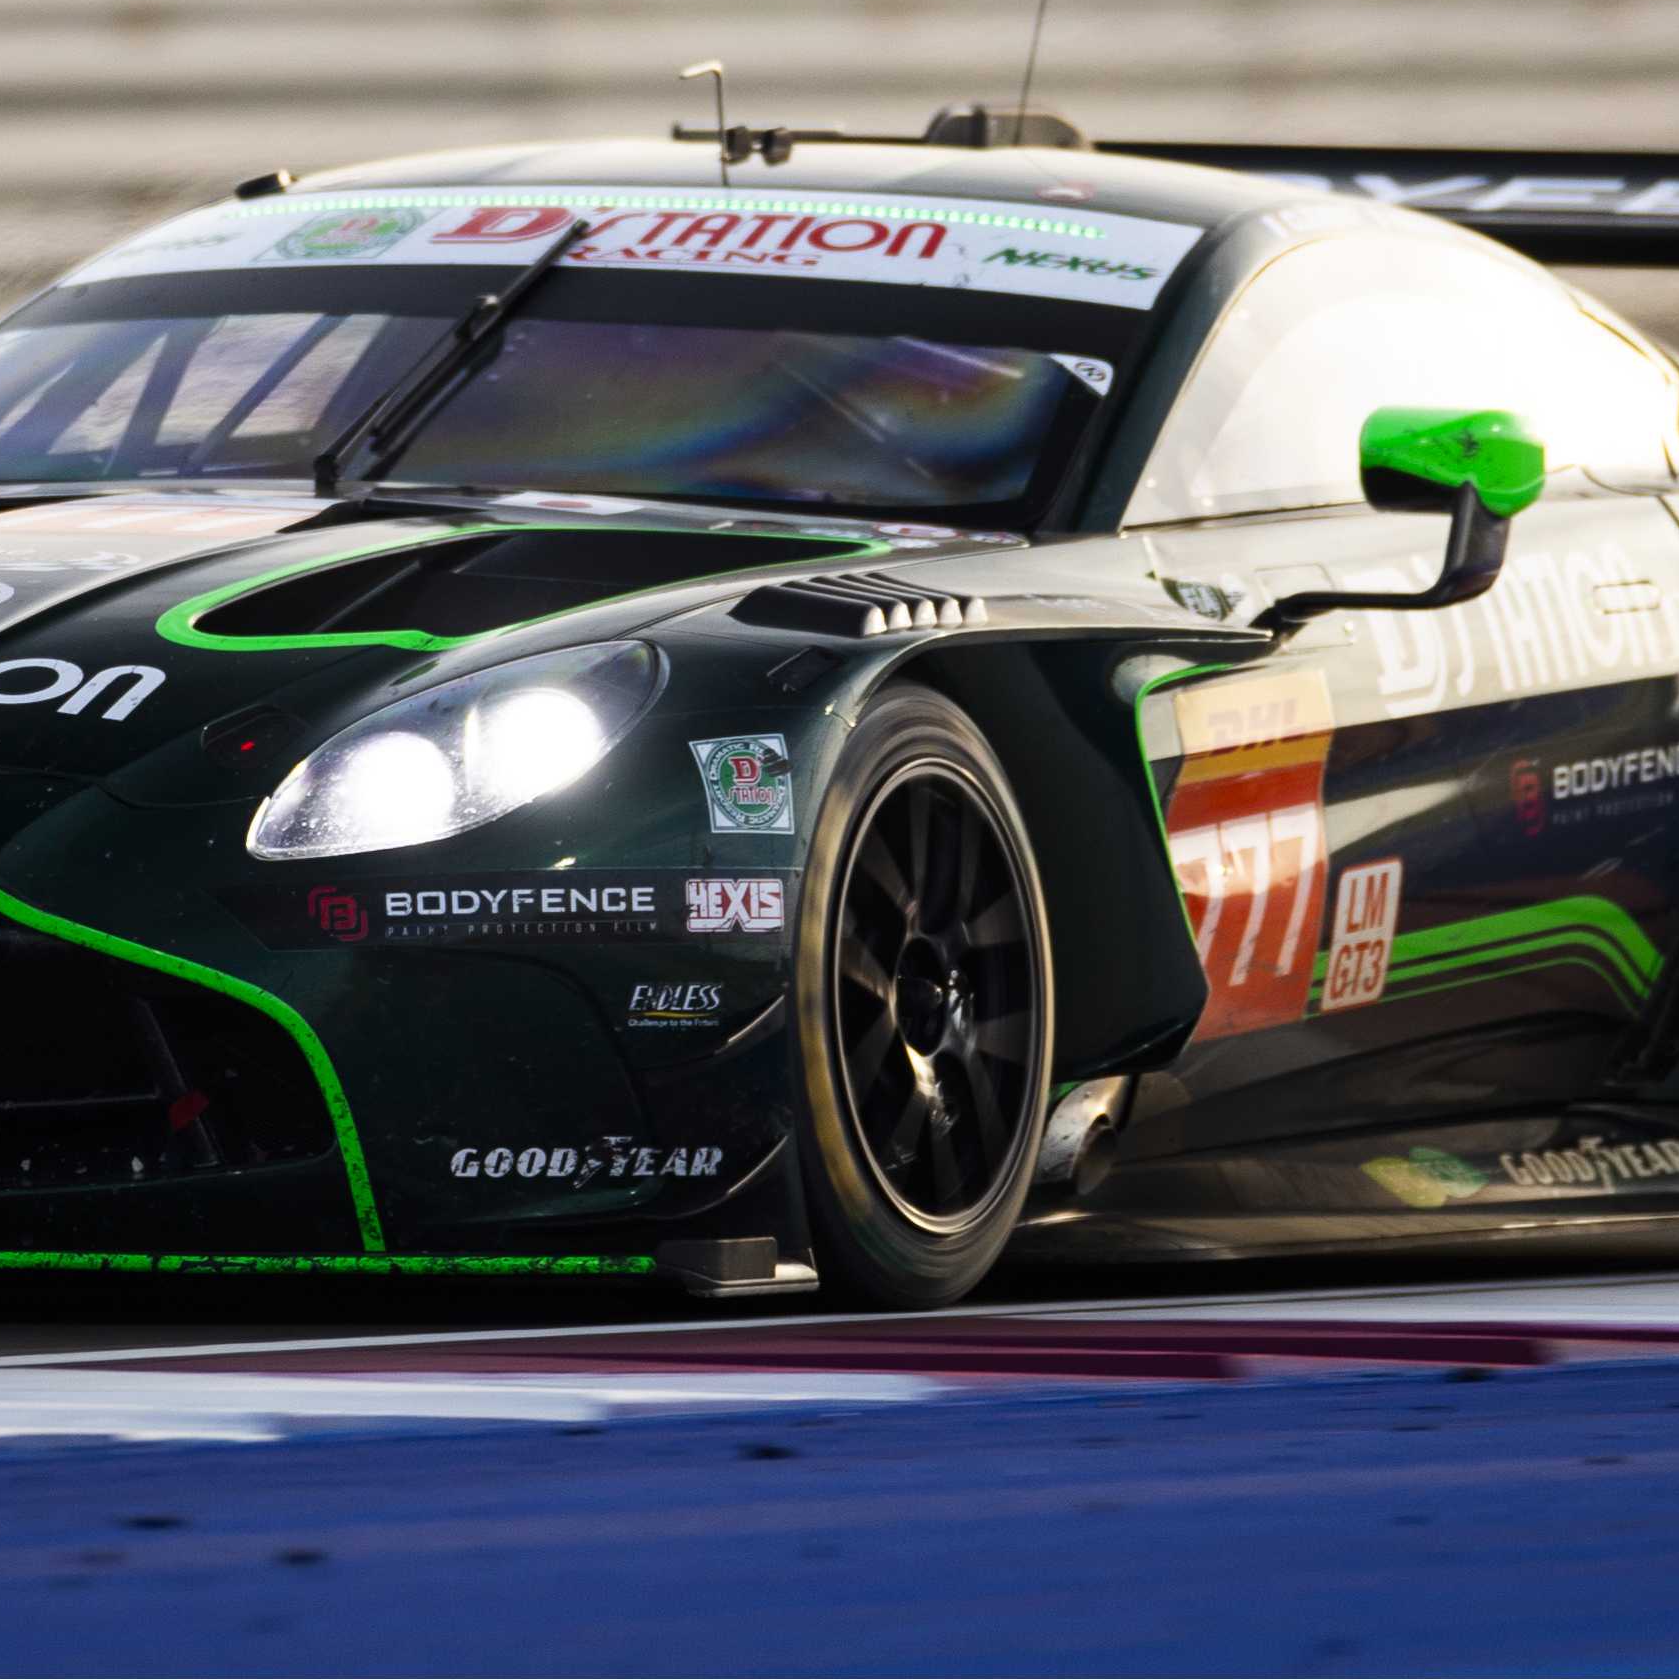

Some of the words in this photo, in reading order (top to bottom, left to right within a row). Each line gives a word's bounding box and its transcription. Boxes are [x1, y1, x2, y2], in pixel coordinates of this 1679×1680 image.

[384, 886, 656, 917] BODYFENCE
[686, 879, 784, 932] HEXIS
[1171, 802, 1320, 987] 777
[1344, 871, 1390, 935] LM
[1328, 937, 1388, 1001] GT3
[450, 1137, 724, 1186] GOODYEAR
